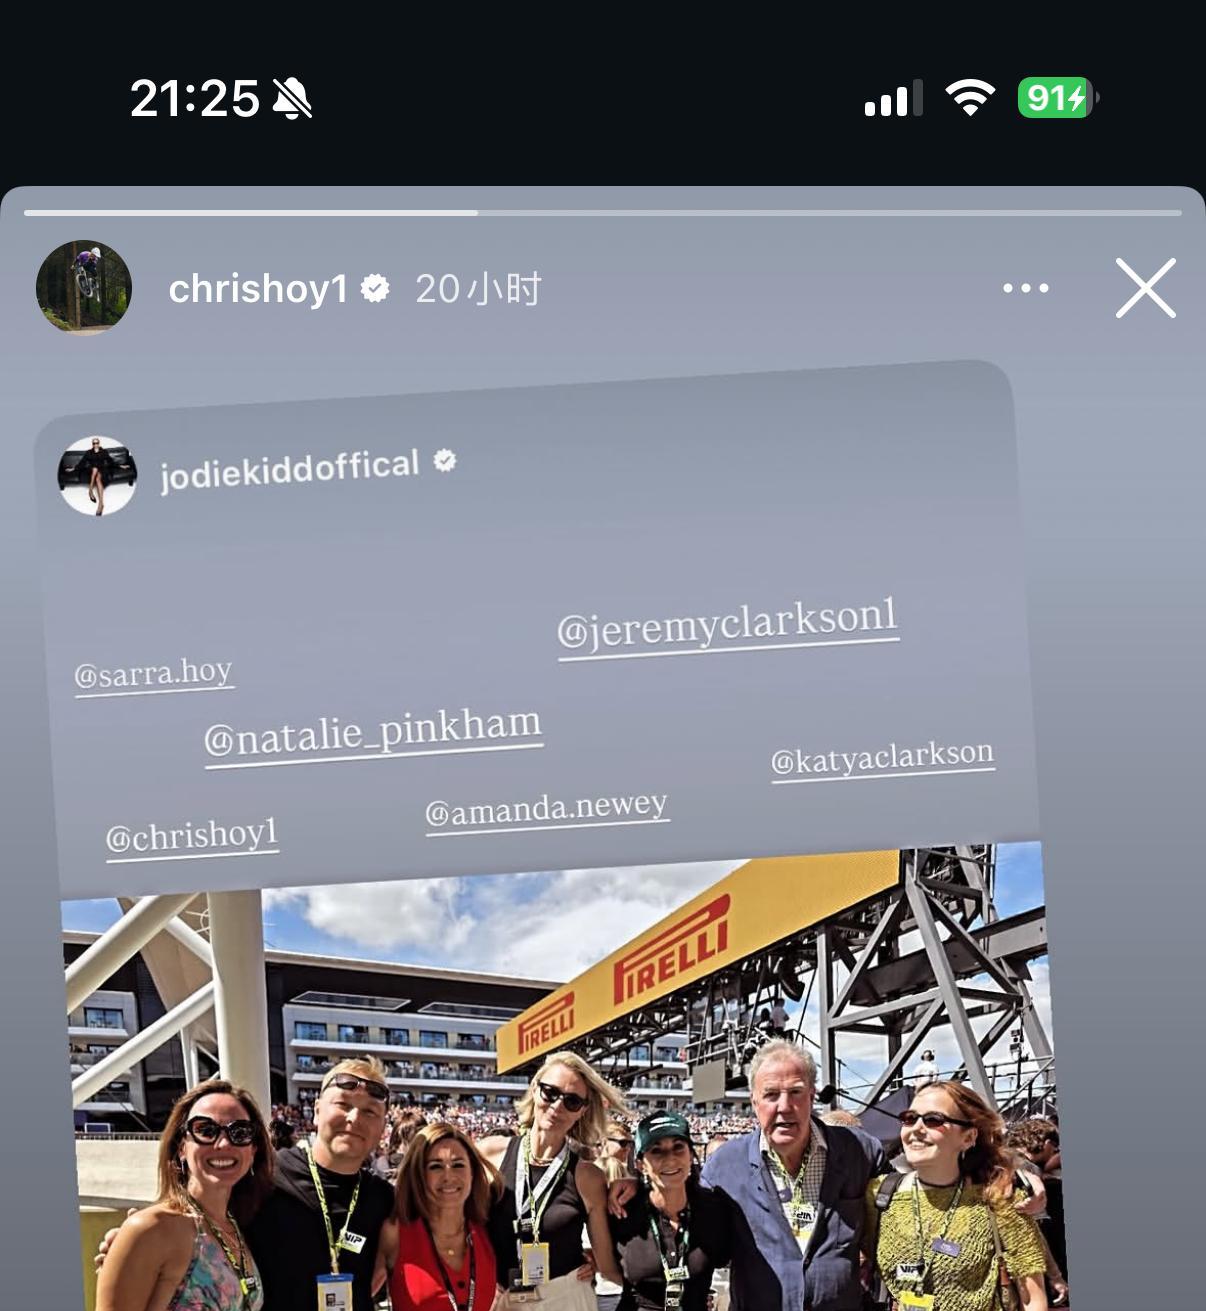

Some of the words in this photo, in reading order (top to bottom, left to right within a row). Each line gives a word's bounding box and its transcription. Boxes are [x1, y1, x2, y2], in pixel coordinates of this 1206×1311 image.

[614, 893, 731, 1006] PIRELLI
[518, 991, 575, 1055] PIRELLI
[345, 1231, 363, 1244] VIP
